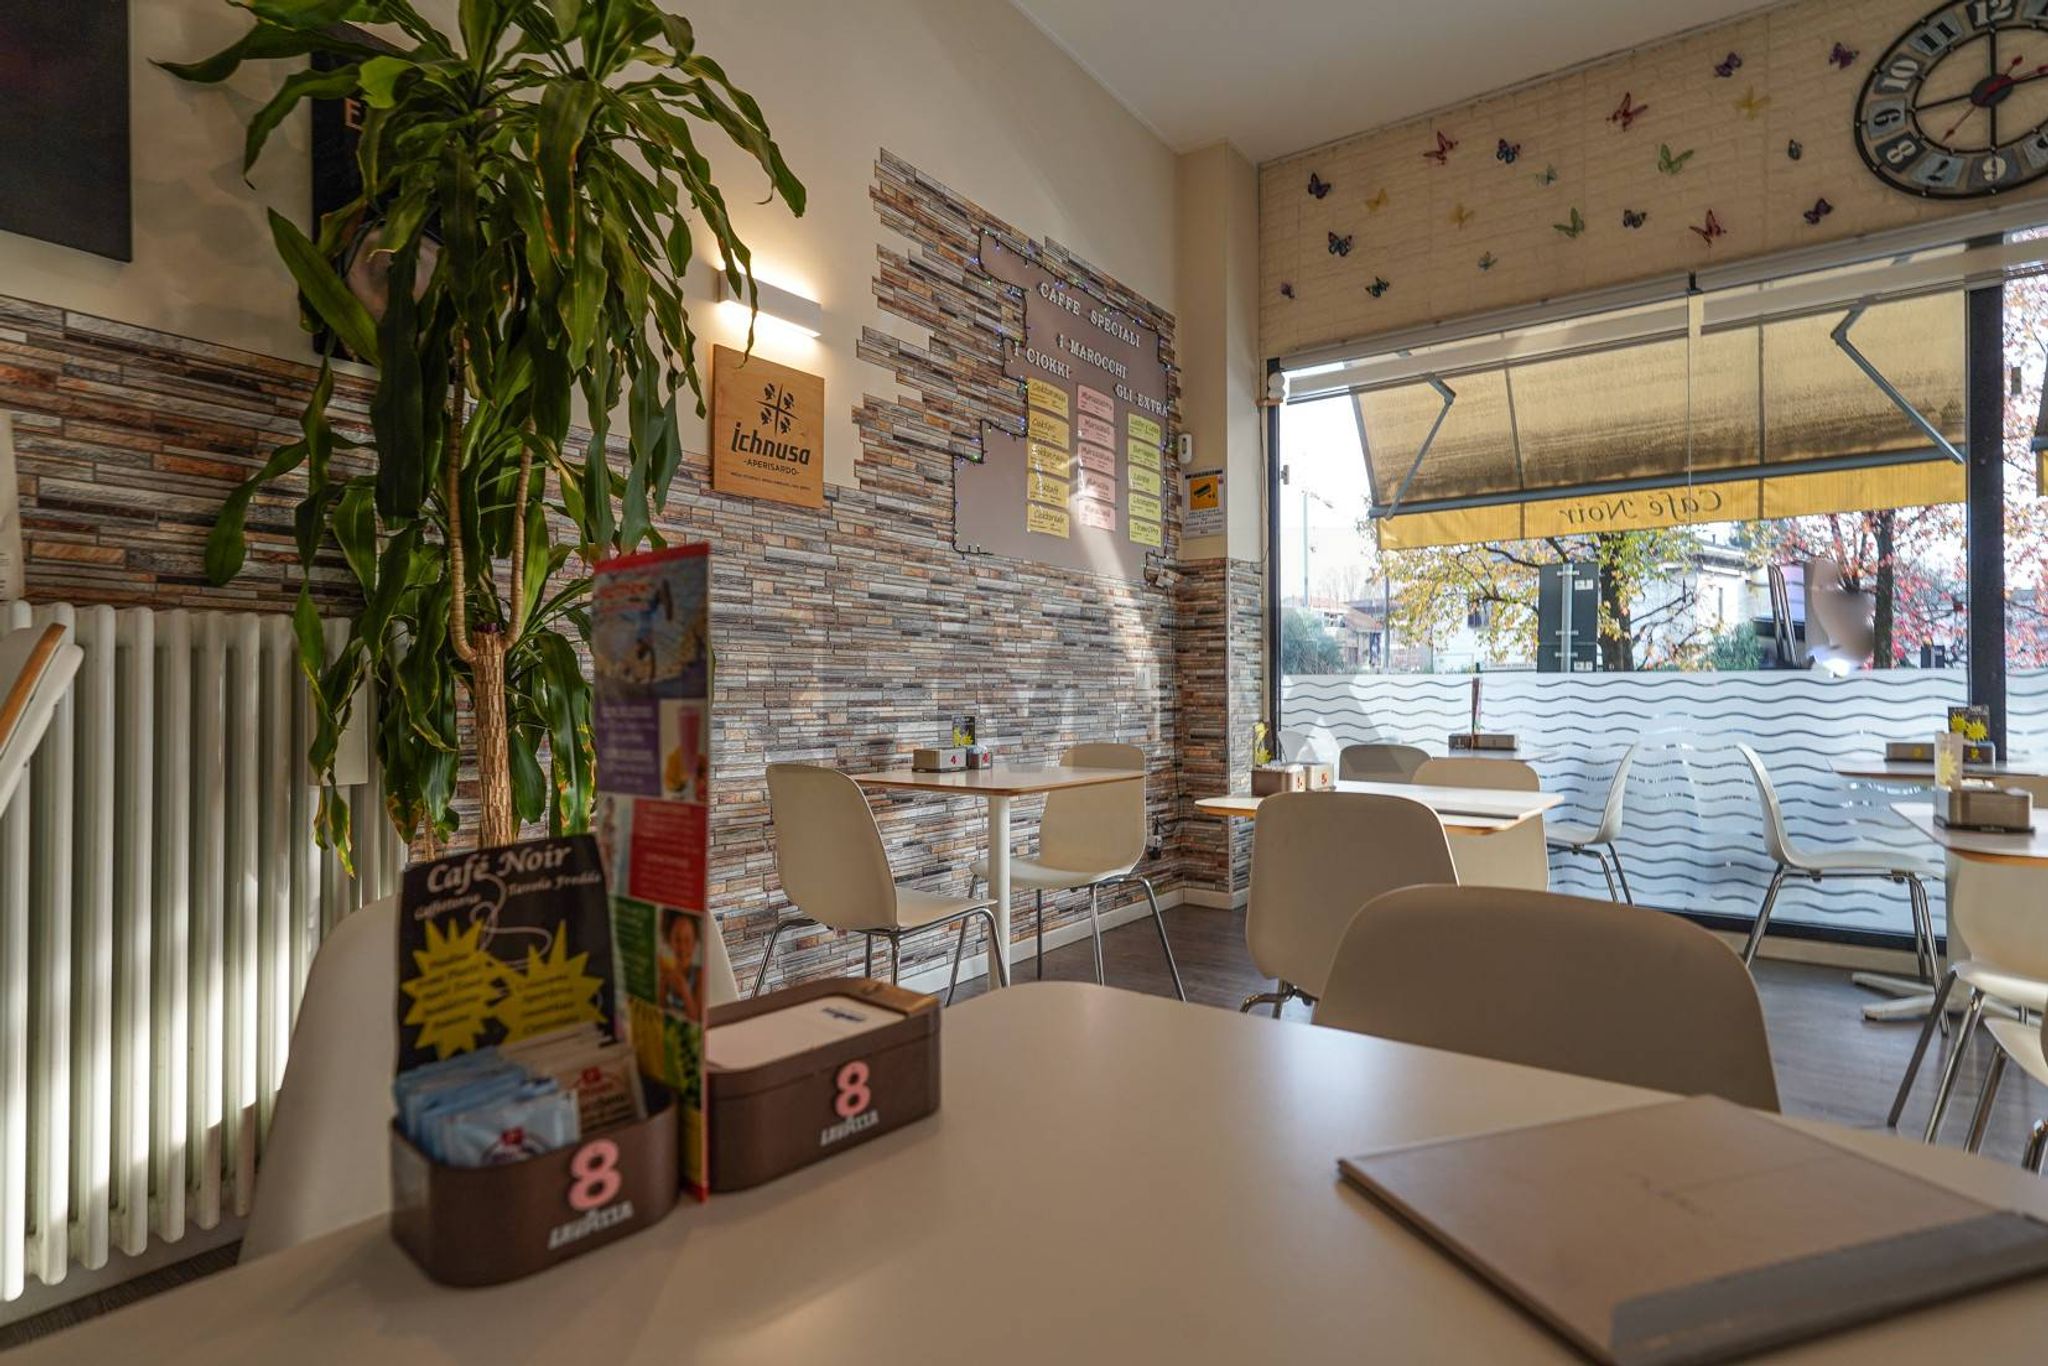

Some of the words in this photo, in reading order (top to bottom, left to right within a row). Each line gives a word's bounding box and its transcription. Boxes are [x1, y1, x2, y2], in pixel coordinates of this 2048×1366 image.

[1975, 0, 2014, 27] 12
[1920, 22, 1957, 51] 11
[1881, 59, 1919, 90] 10
[1886, 139, 1917, 164] 8
[1039, 282, 1081, 316] CAFFE
[1089, 310, 1141, 348] SPECIALI
[1026, 348, 1071, 379] CIOKKI
[1058, 334, 1065, 348] I
[1069, 339, 1127, 379] MAROCCHI
[1115, 383, 1132, 401] GLI
[730, 421, 811, 465] ichnusa
[427, 854, 489, 895] Café
[496, 843, 573, 878] Noir
[834, 1060, 871, 1118] 8
[568, 1138, 622, 1212] 8
